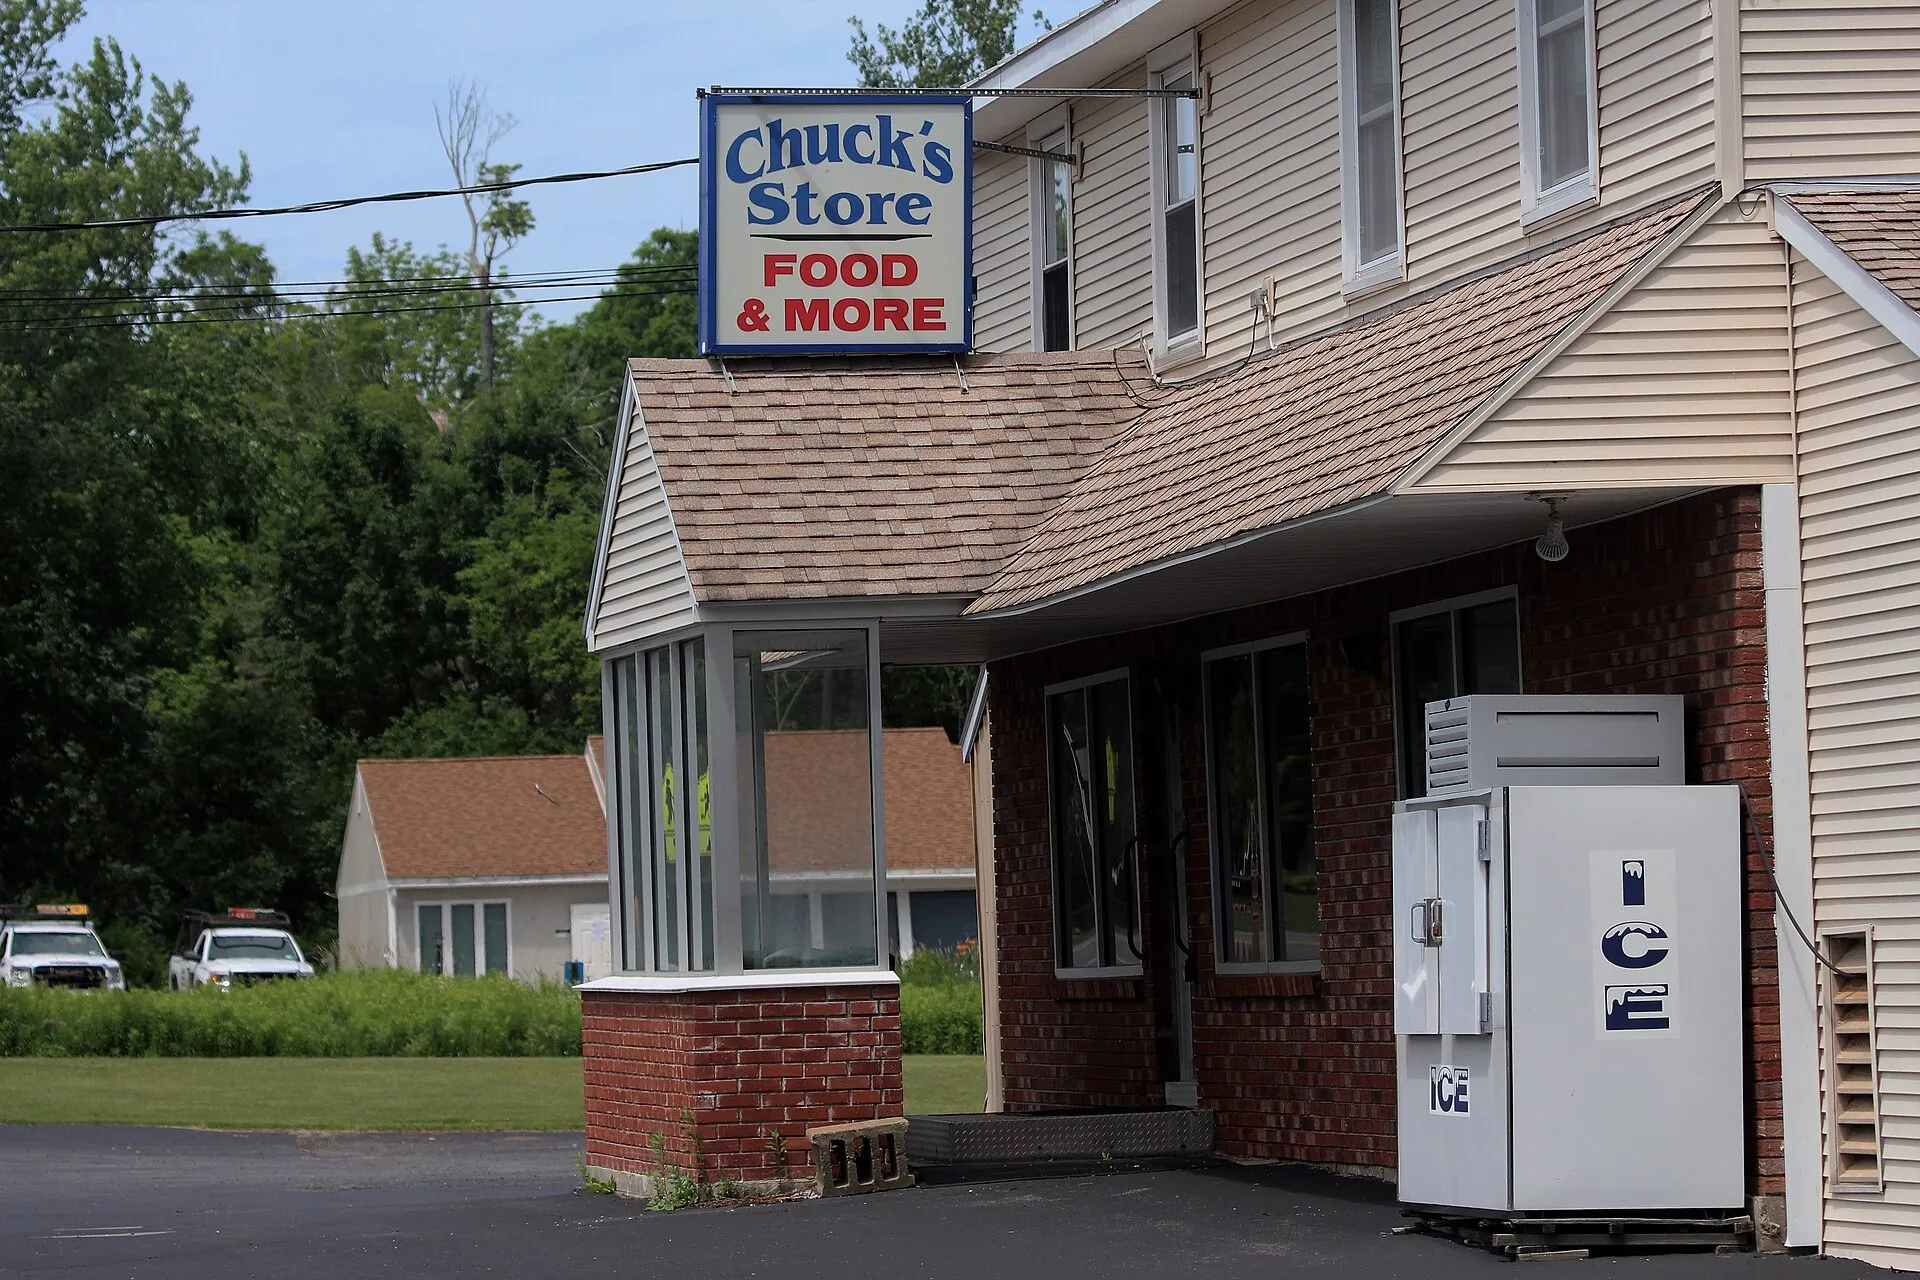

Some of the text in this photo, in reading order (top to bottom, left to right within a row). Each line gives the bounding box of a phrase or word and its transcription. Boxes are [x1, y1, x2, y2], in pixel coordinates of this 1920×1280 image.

[725, 114, 954, 184] Chuck's
[747, 182, 932, 225] Store
[763, 254, 918, 287] FOOD
[736, 298, 947, 331] & MORE
[1602, 860, 1670, 1030] ICE
[1431, 1066, 1469, 1113] ICE
